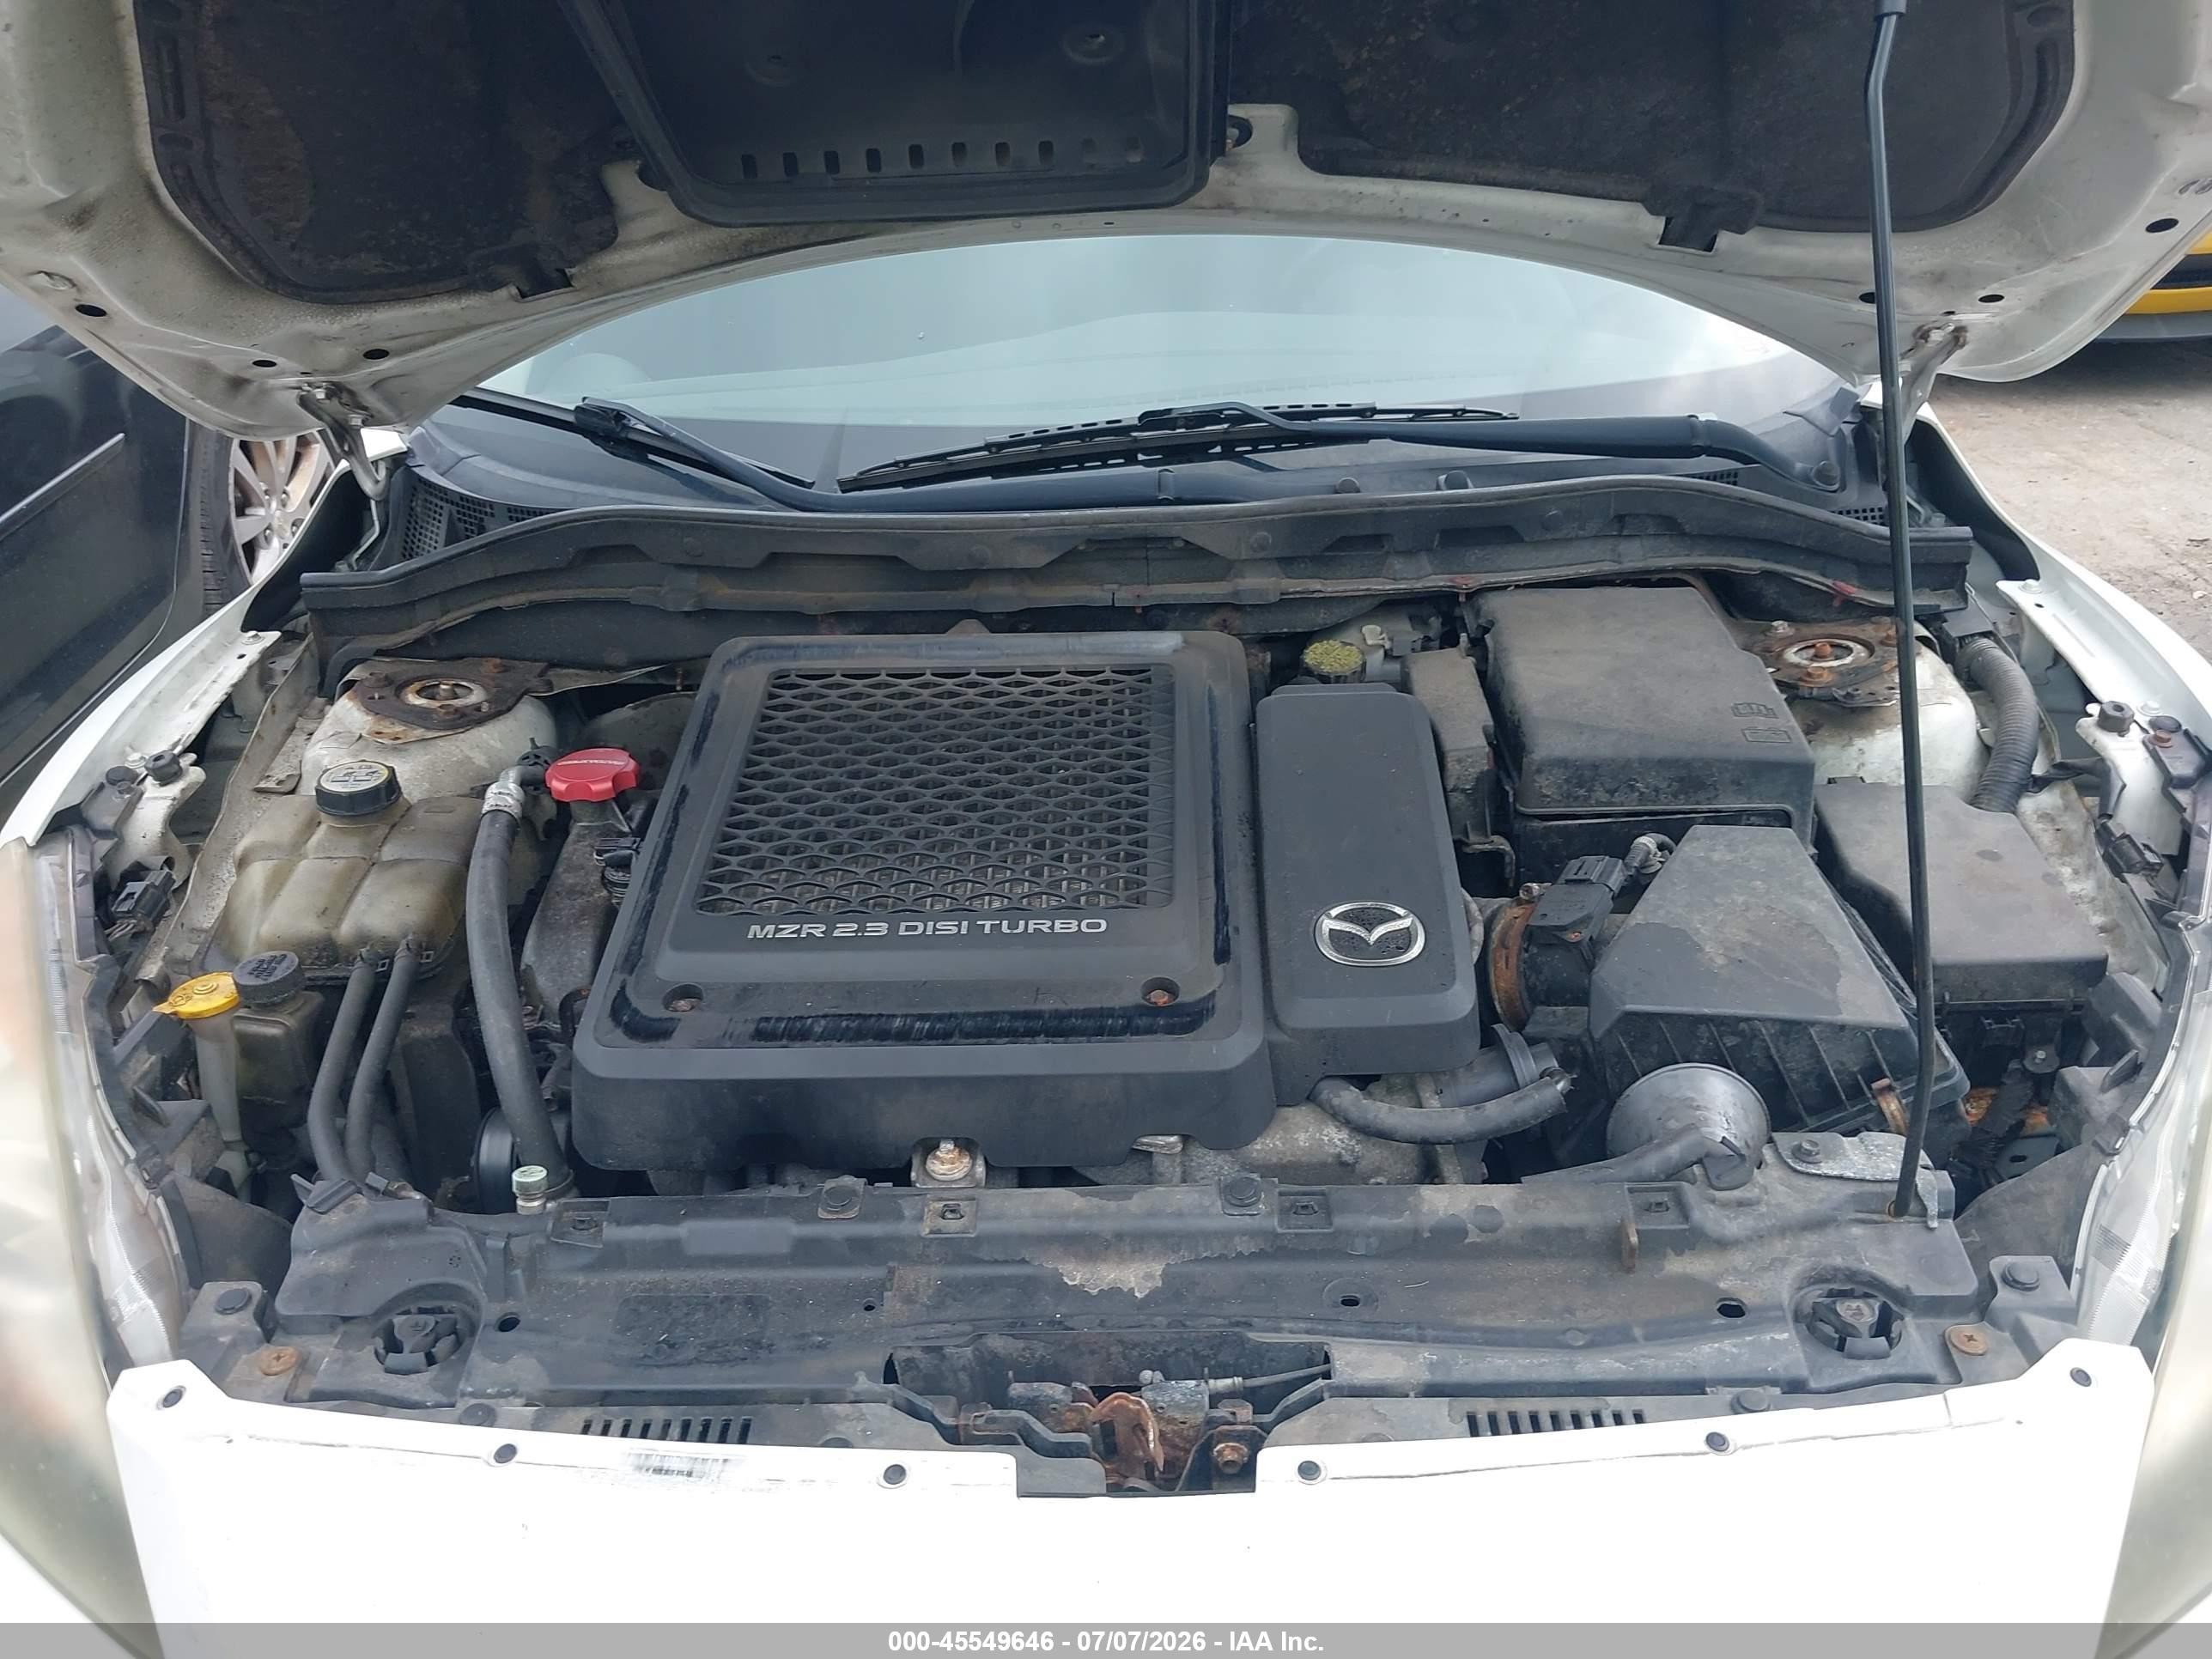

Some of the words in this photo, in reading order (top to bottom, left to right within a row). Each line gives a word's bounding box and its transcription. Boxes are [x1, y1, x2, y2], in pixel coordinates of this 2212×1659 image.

[747, 923, 827, 939] MZR
[832, 921, 889, 937] 2.3
[897, 921, 969, 936] DISI
[975, 919, 1108, 934] TURBO
